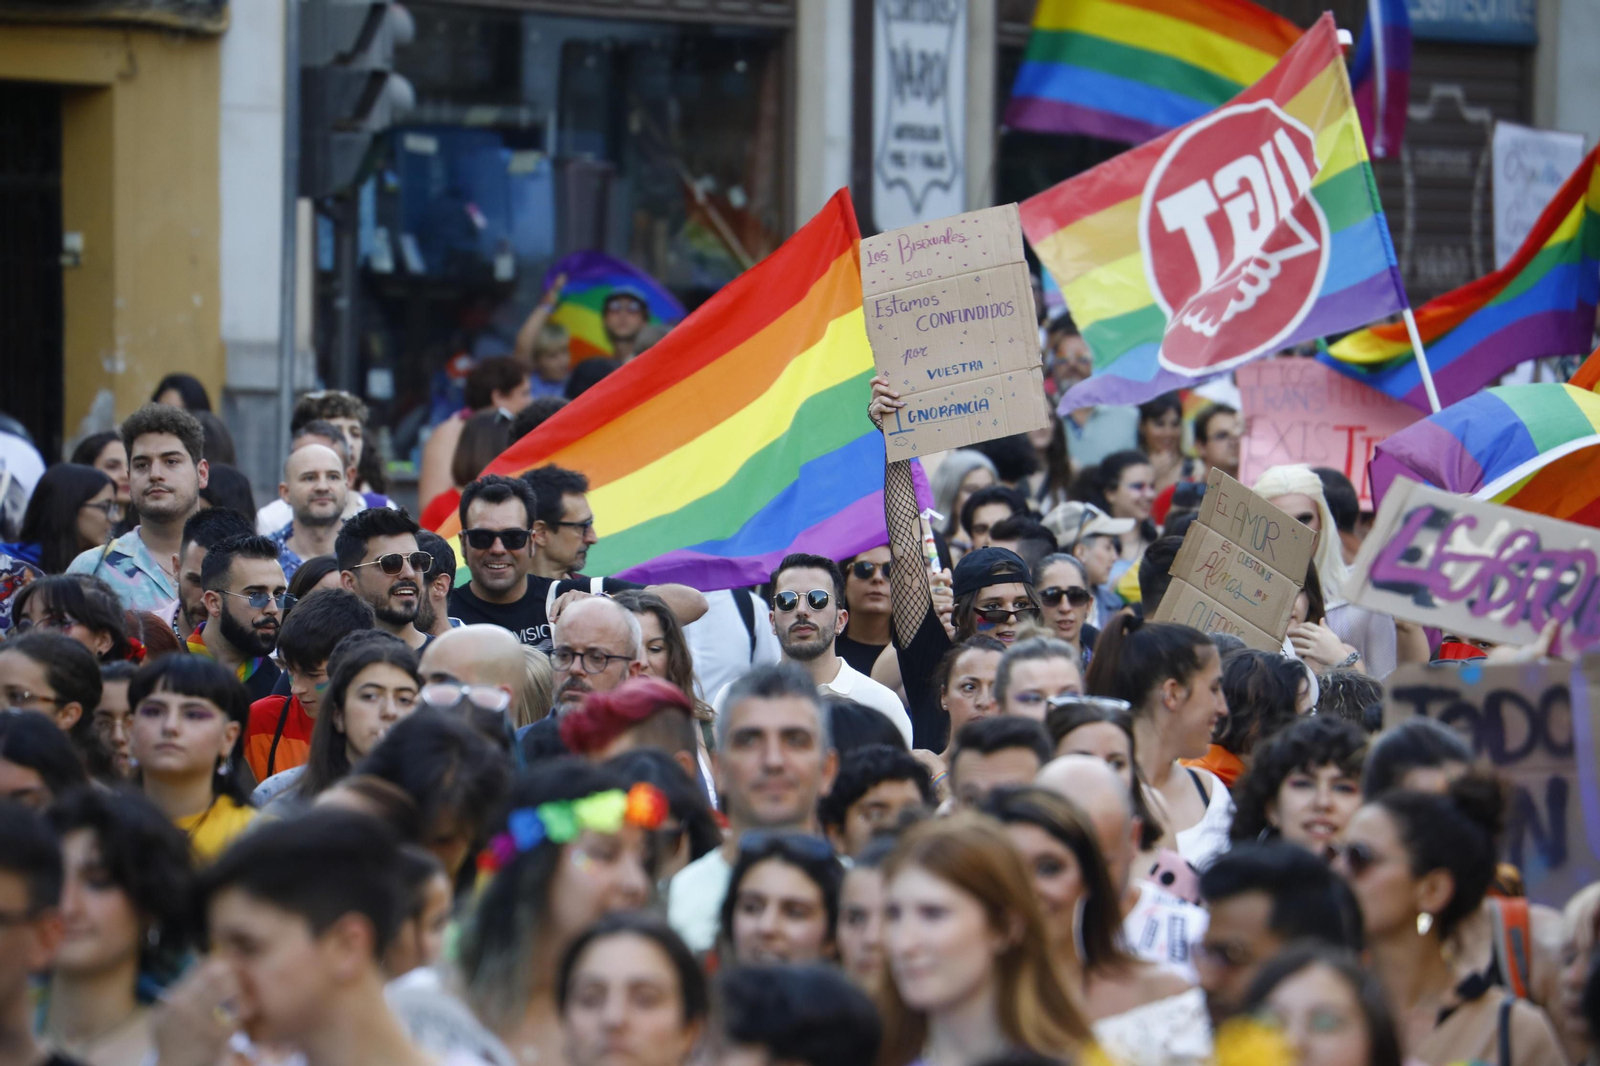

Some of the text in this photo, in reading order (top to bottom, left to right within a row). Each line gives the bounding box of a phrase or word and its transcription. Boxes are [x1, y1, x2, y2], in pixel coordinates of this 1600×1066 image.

[867, 249, 889, 267] Los
[905, 267, 933, 281] SOLO
[875, 294, 940, 318] Estamos
[915, 300, 1015, 332] CONFUNDIDOS
[900, 346, 928, 366] por
[926, 360, 984, 380] VUESTRA
[888, 398, 990, 436] IGNORANCIA
[1230, 501, 1281, 562] AMOR
[1220, 540, 1232, 554] ES
[510, 623, 551, 644] VISIO
